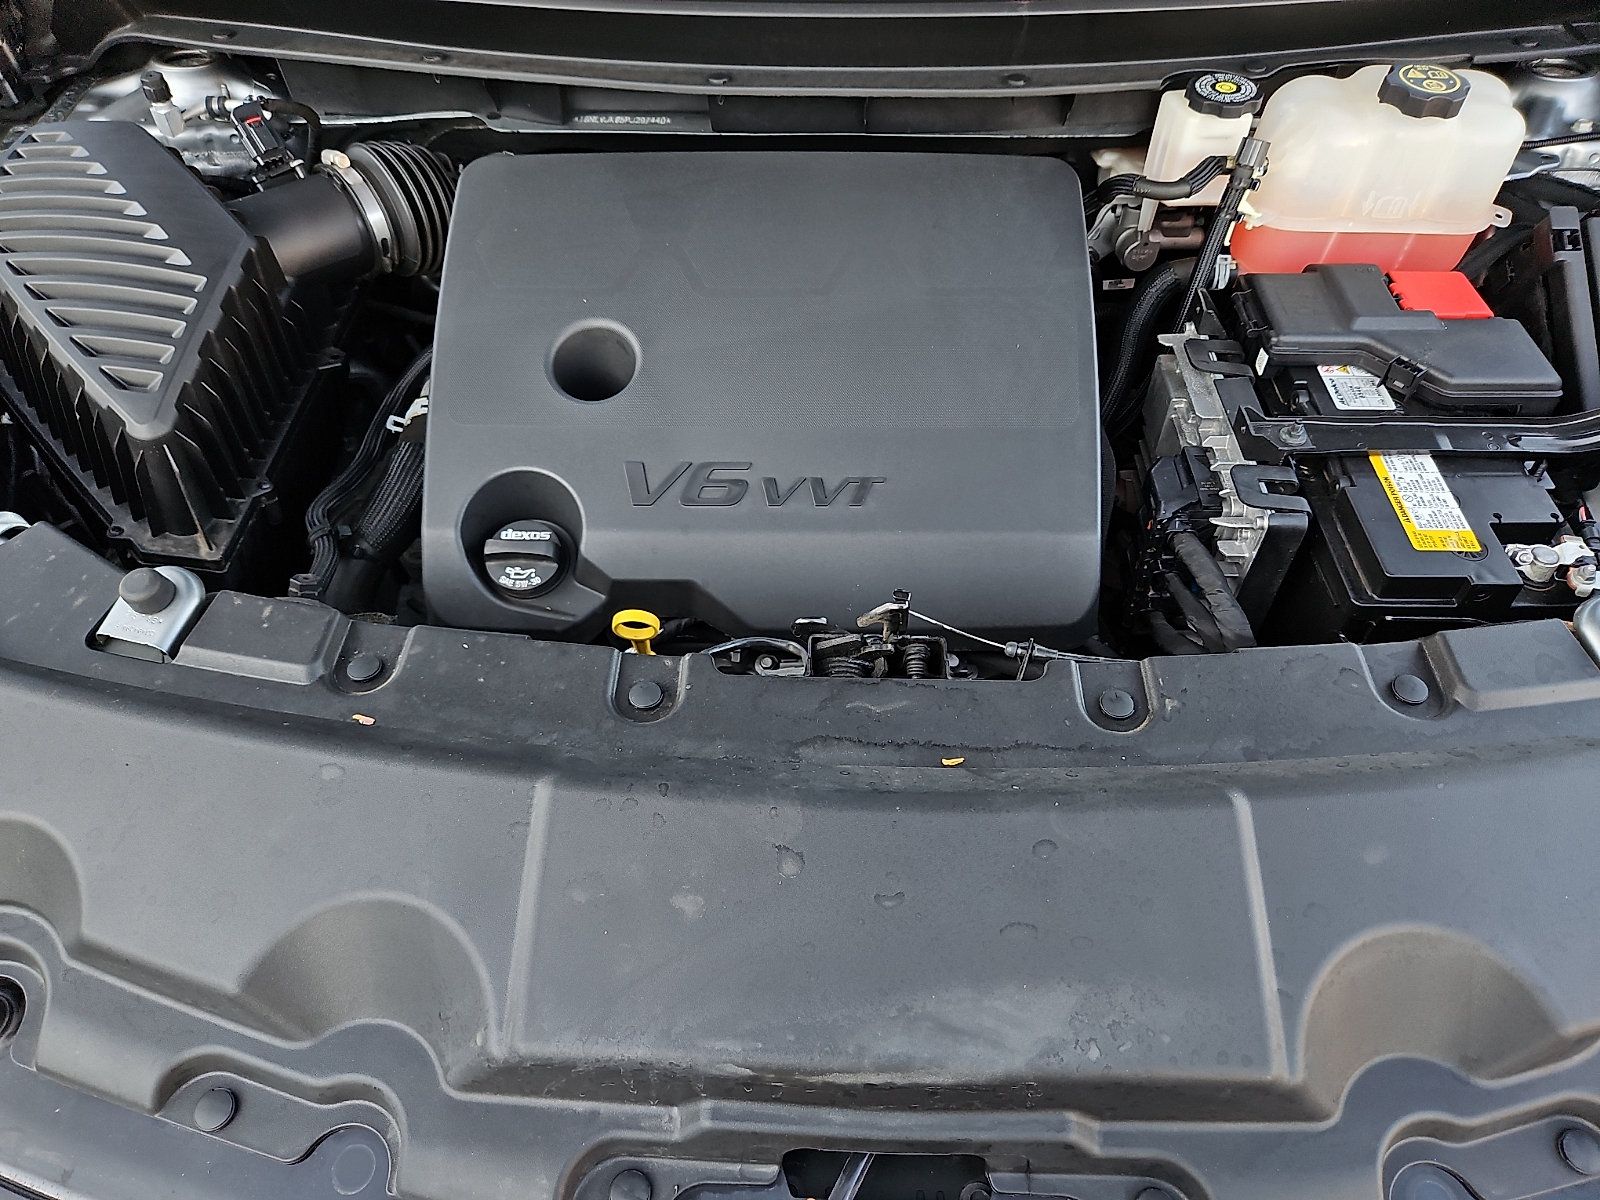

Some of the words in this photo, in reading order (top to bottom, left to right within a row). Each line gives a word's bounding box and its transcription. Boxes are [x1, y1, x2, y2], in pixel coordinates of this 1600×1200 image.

[624, 461, 753, 507] V6
[761, 476, 887, 507] VVT
[500, 528, 552, 541] dexos
[498, 575, 515, 587] SAE
